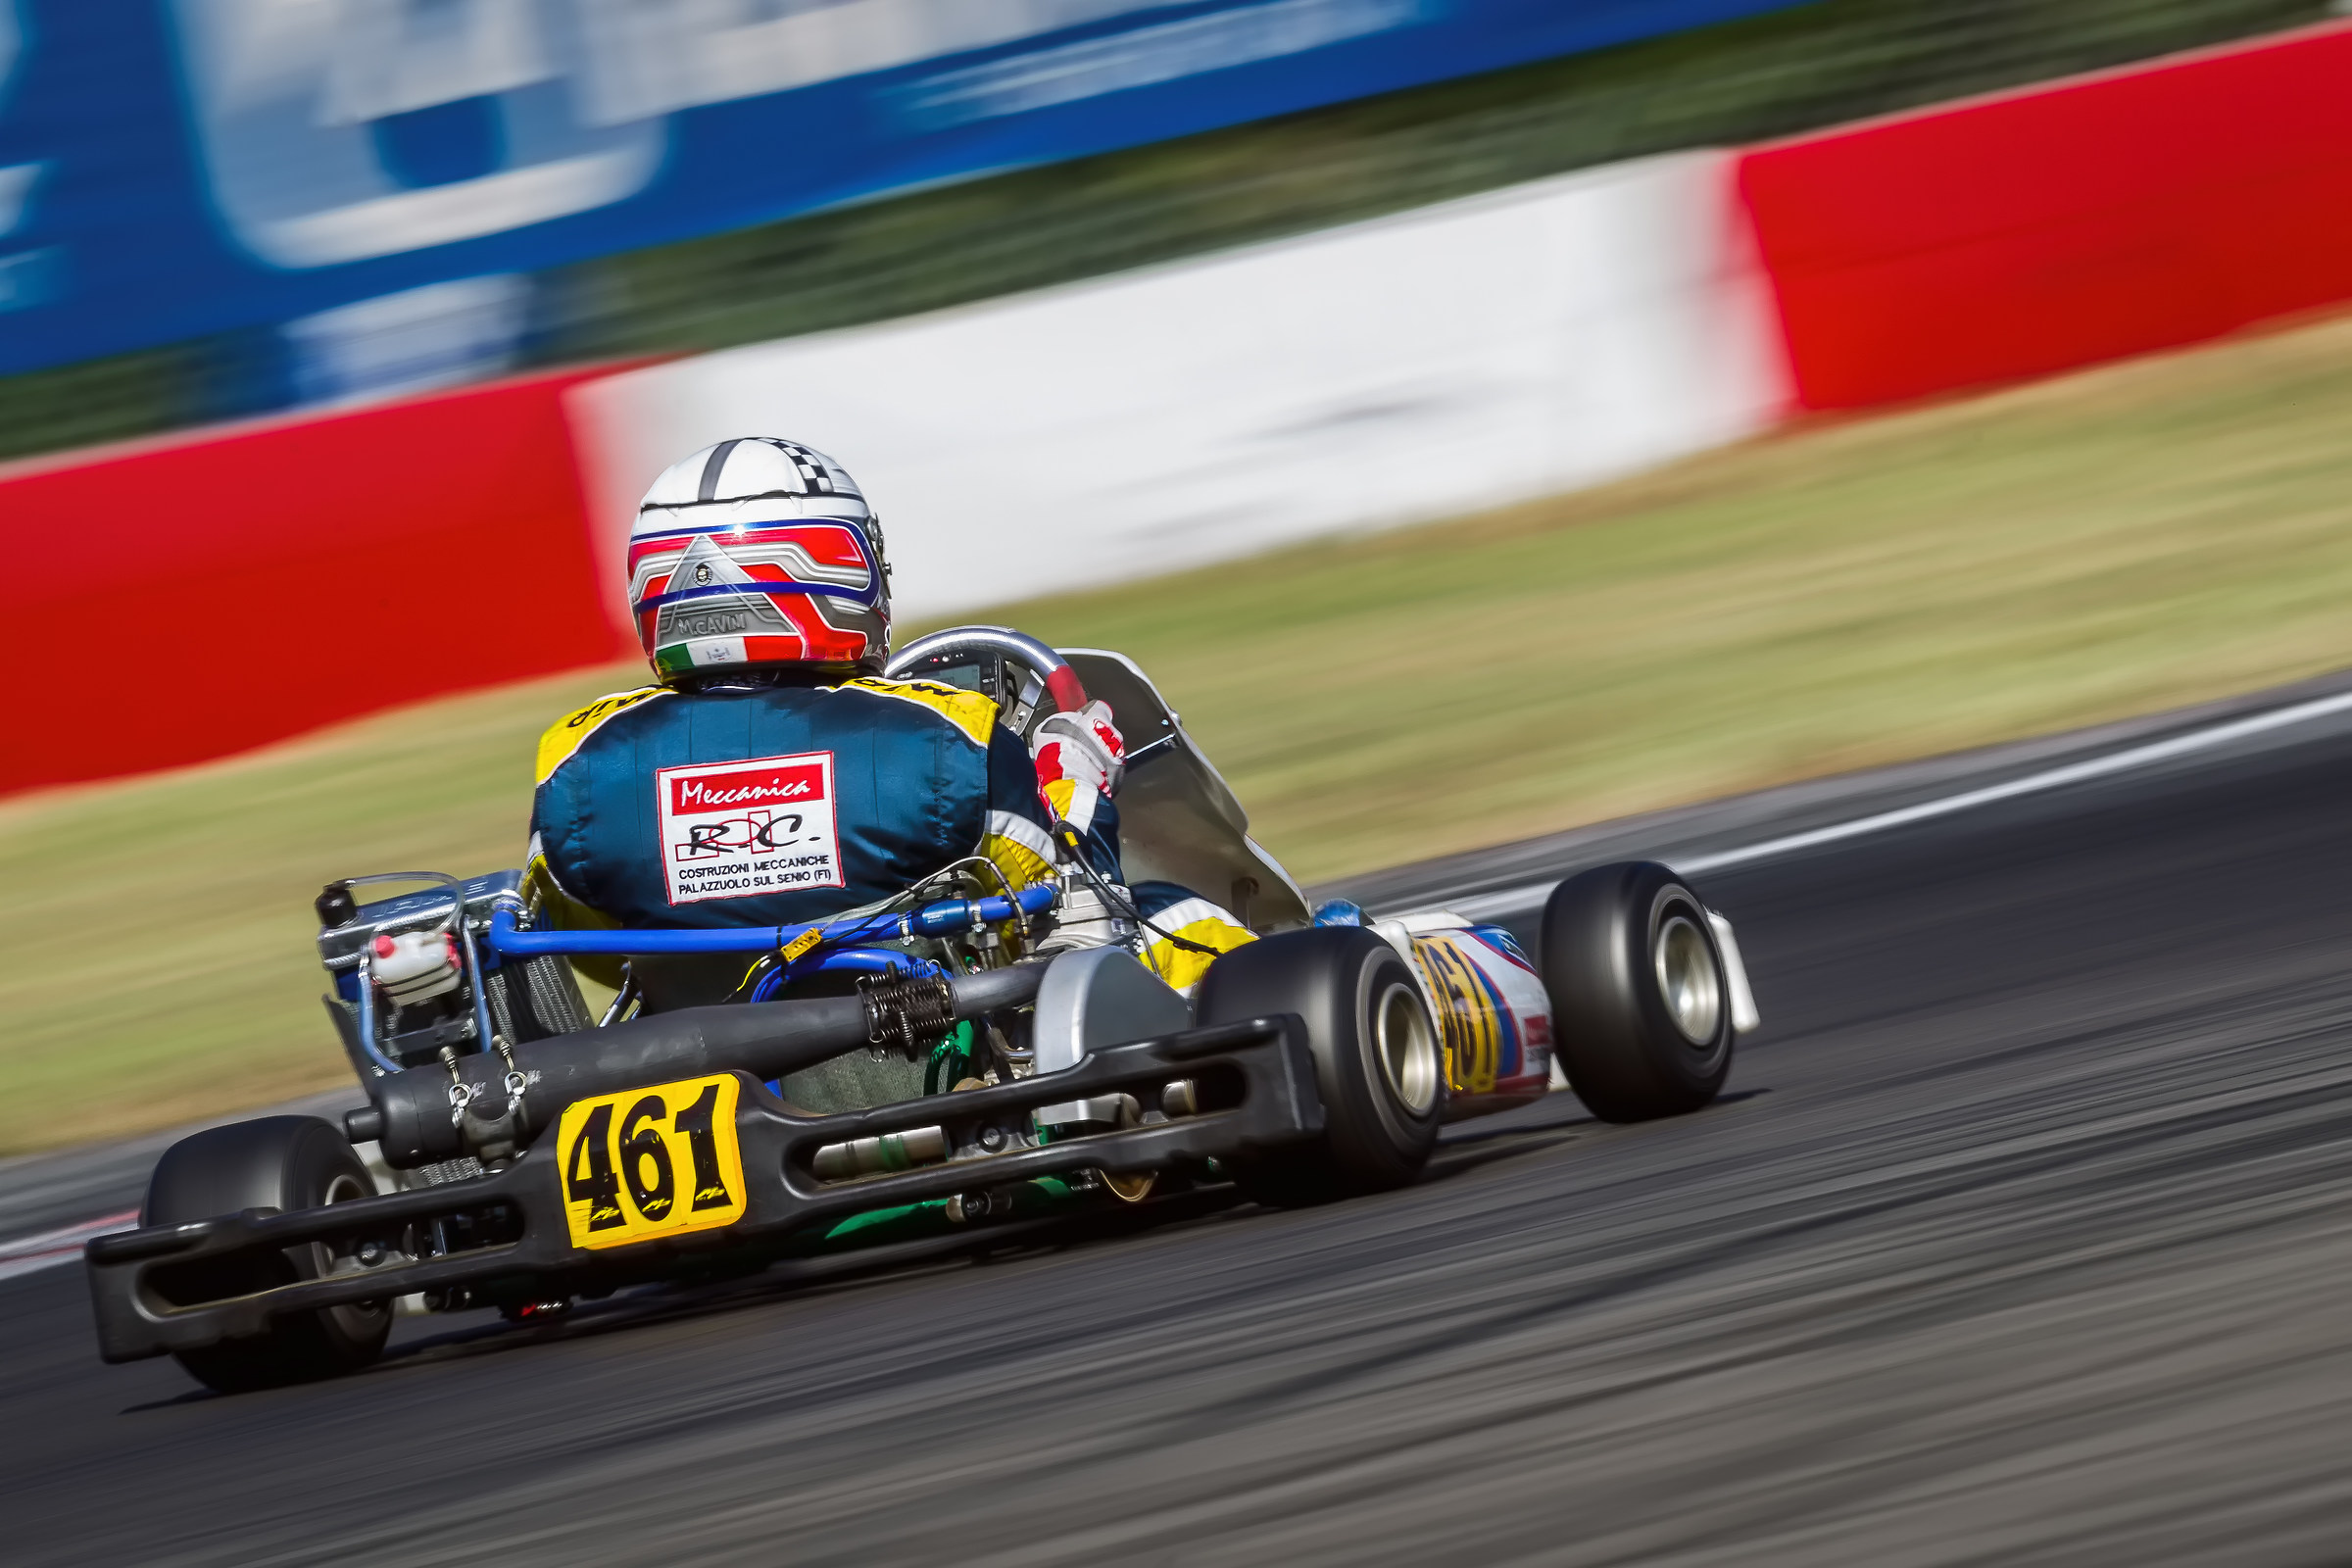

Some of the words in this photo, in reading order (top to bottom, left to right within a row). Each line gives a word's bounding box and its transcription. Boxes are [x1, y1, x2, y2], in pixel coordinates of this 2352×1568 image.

[680, 777, 811, 807] Meccanica
[678, 862, 750, 880] COSTRUZIONI
[754, 855, 830, 872] MECCANICHE
[678, 878, 752, 895] PALAZZUOLO
[754, 876, 775, 887] SUL
[777, 871, 811, 884] SENIO
[566, 1083, 734, 1233] 461
